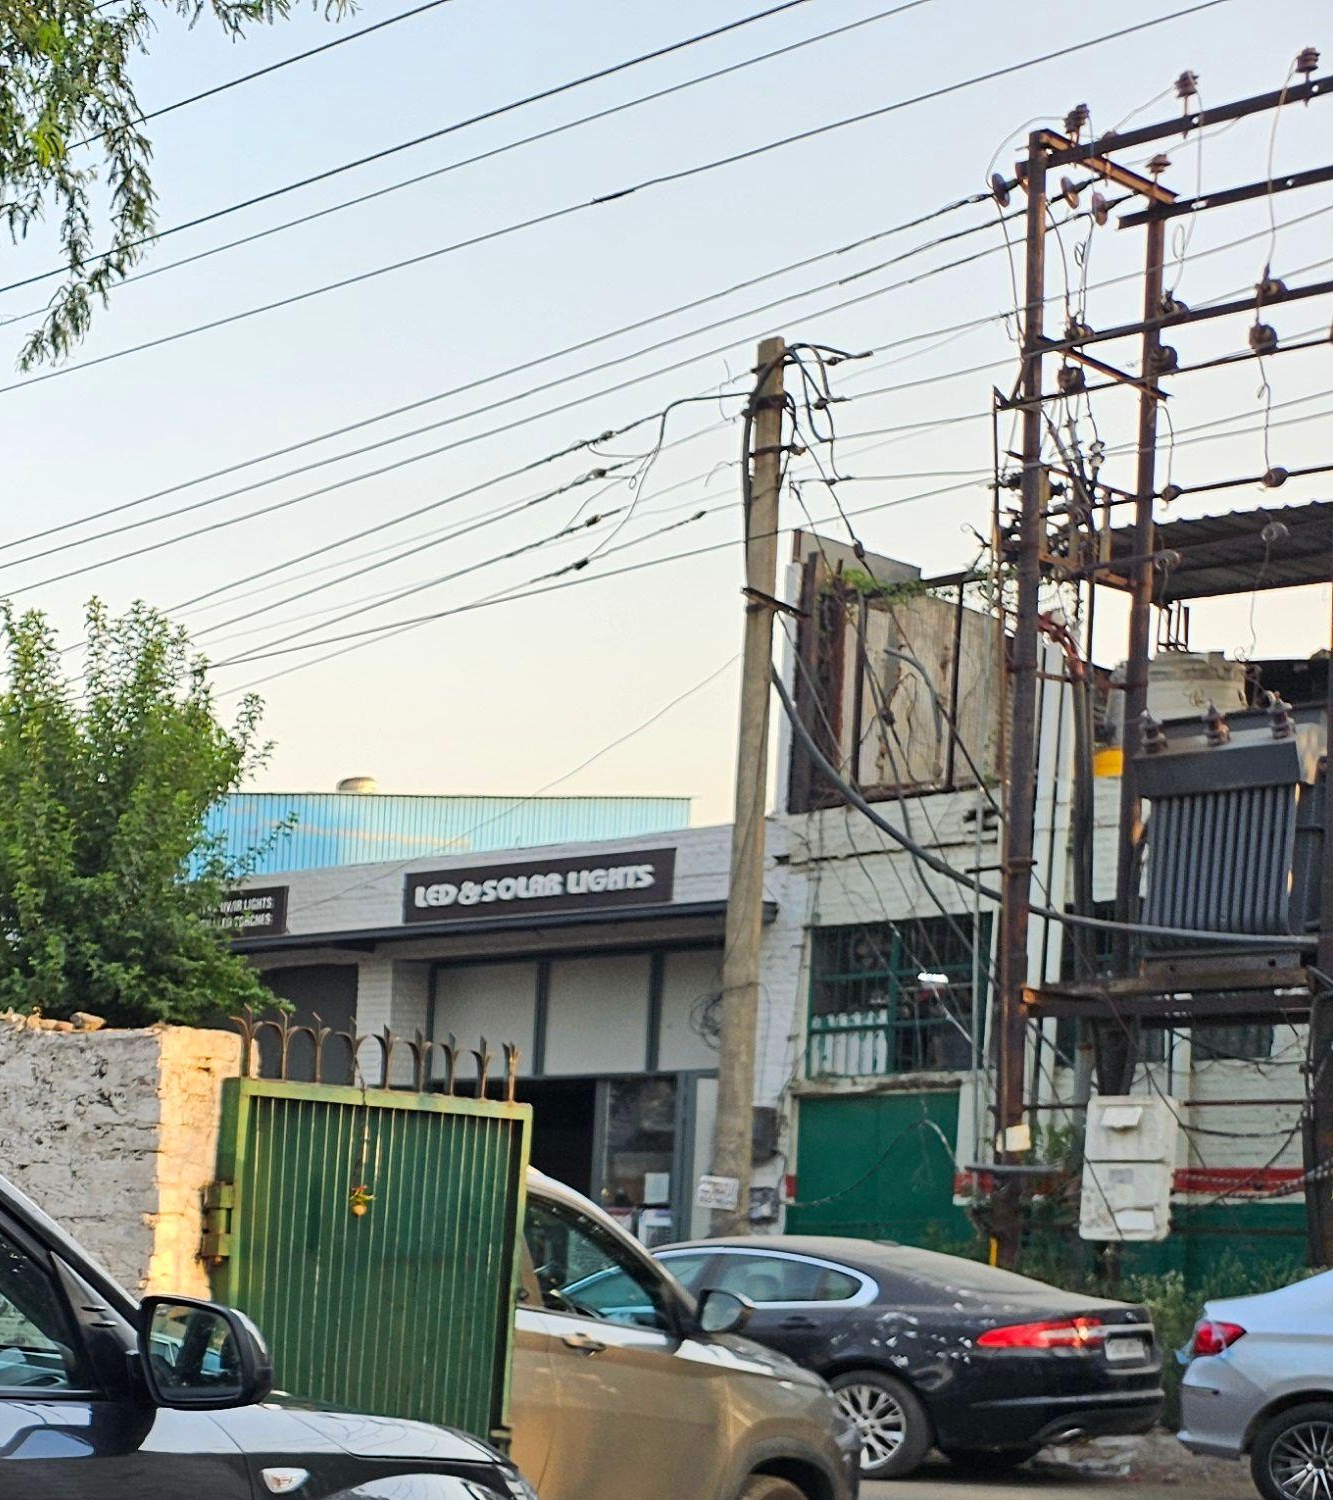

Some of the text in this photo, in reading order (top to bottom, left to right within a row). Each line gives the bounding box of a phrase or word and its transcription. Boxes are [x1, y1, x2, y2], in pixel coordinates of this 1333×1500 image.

[414, 864, 656, 908] LED & SOLAR LIGHTS
